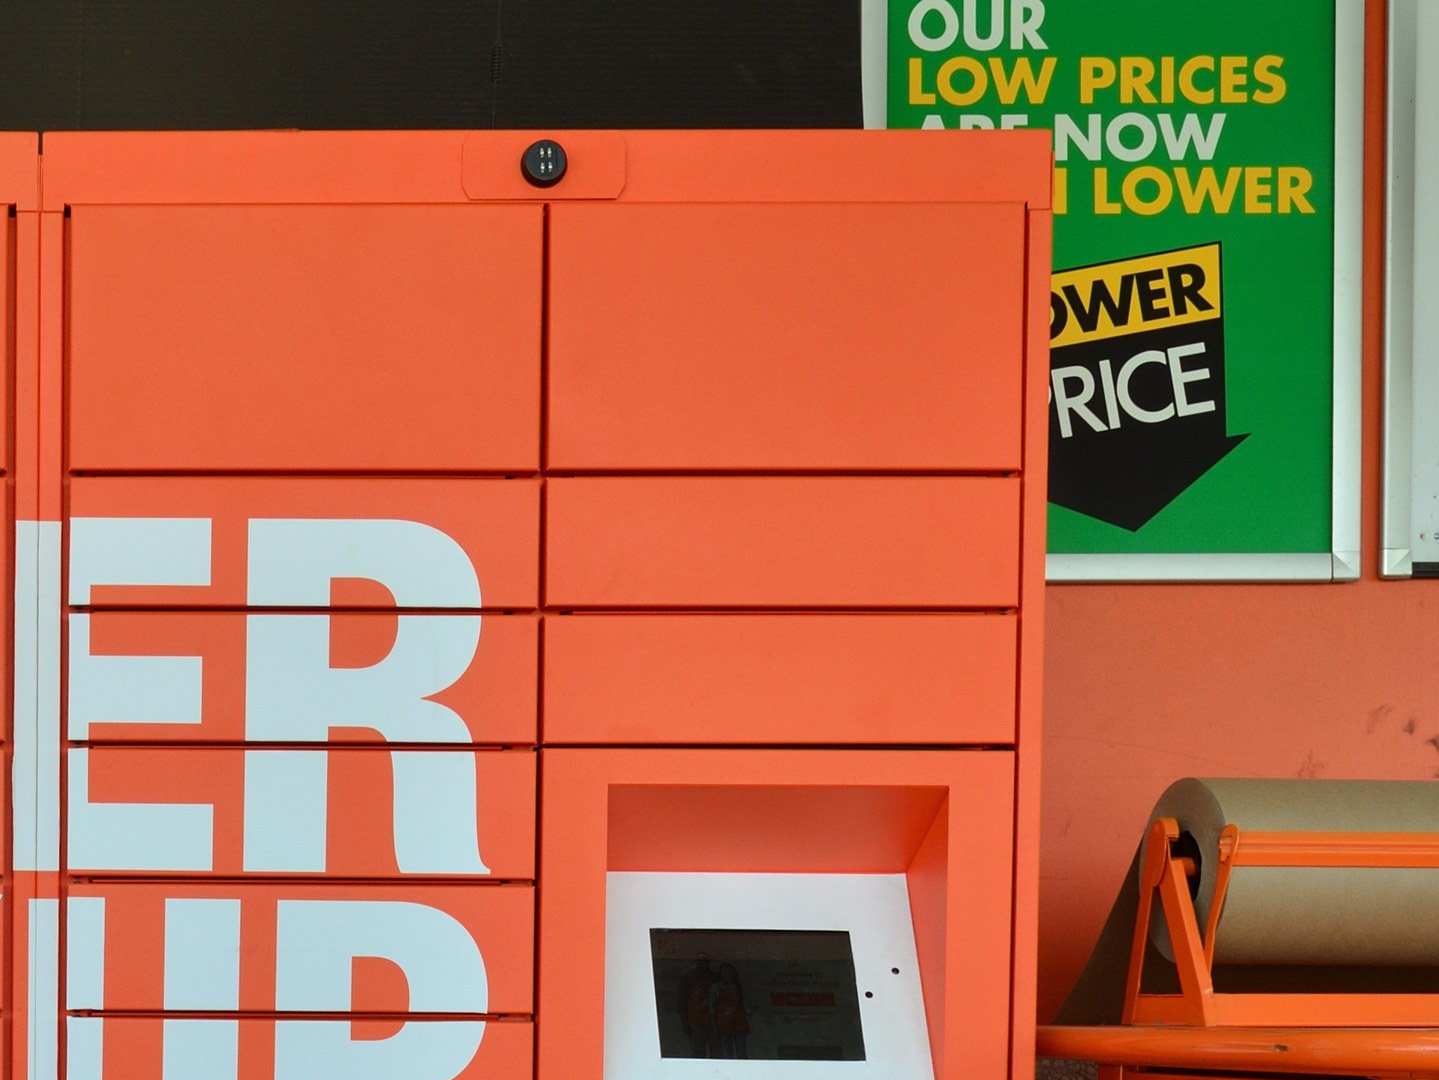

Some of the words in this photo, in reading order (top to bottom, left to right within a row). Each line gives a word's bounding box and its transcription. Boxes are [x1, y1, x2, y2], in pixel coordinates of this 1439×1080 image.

[907, 0, 1048, 51] OUR
[908, 57, 1058, 106] LOW
[1079, 55, 1287, 105] PRICES
[1054, 112, 1227, 161] NOW
[1093, 166, 1316, 215] LOWER
[1048, 342, 1216, 438] RICE
